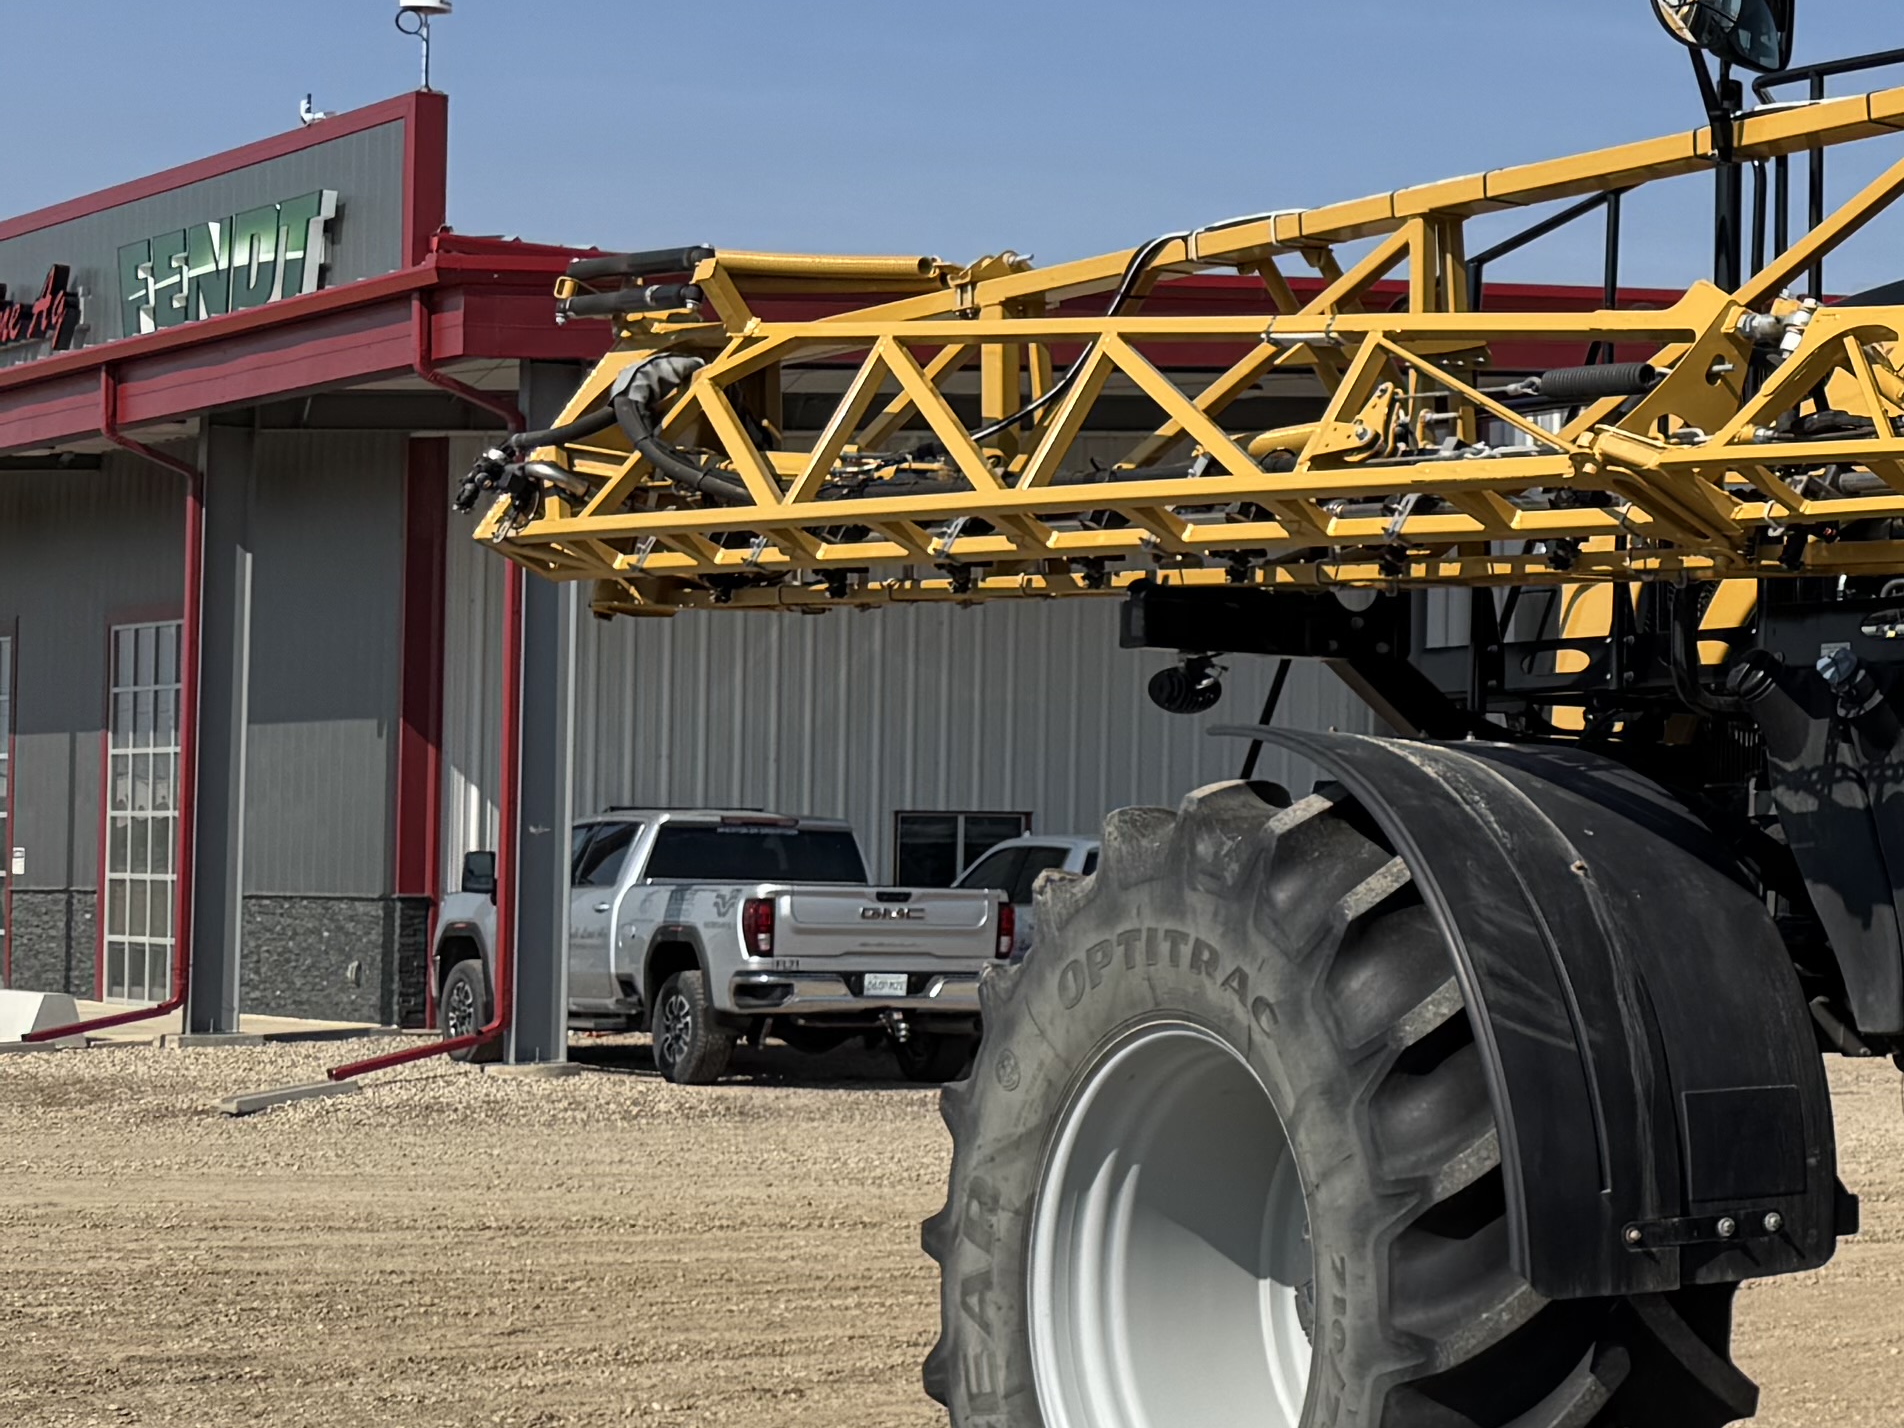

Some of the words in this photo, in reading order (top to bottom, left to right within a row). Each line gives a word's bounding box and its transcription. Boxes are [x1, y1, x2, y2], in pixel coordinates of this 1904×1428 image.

[118, 189, 334, 337] FENDT
[860, 907, 926, 920] GMC
[1058, 927, 1279, 1037] OPTITRAC
